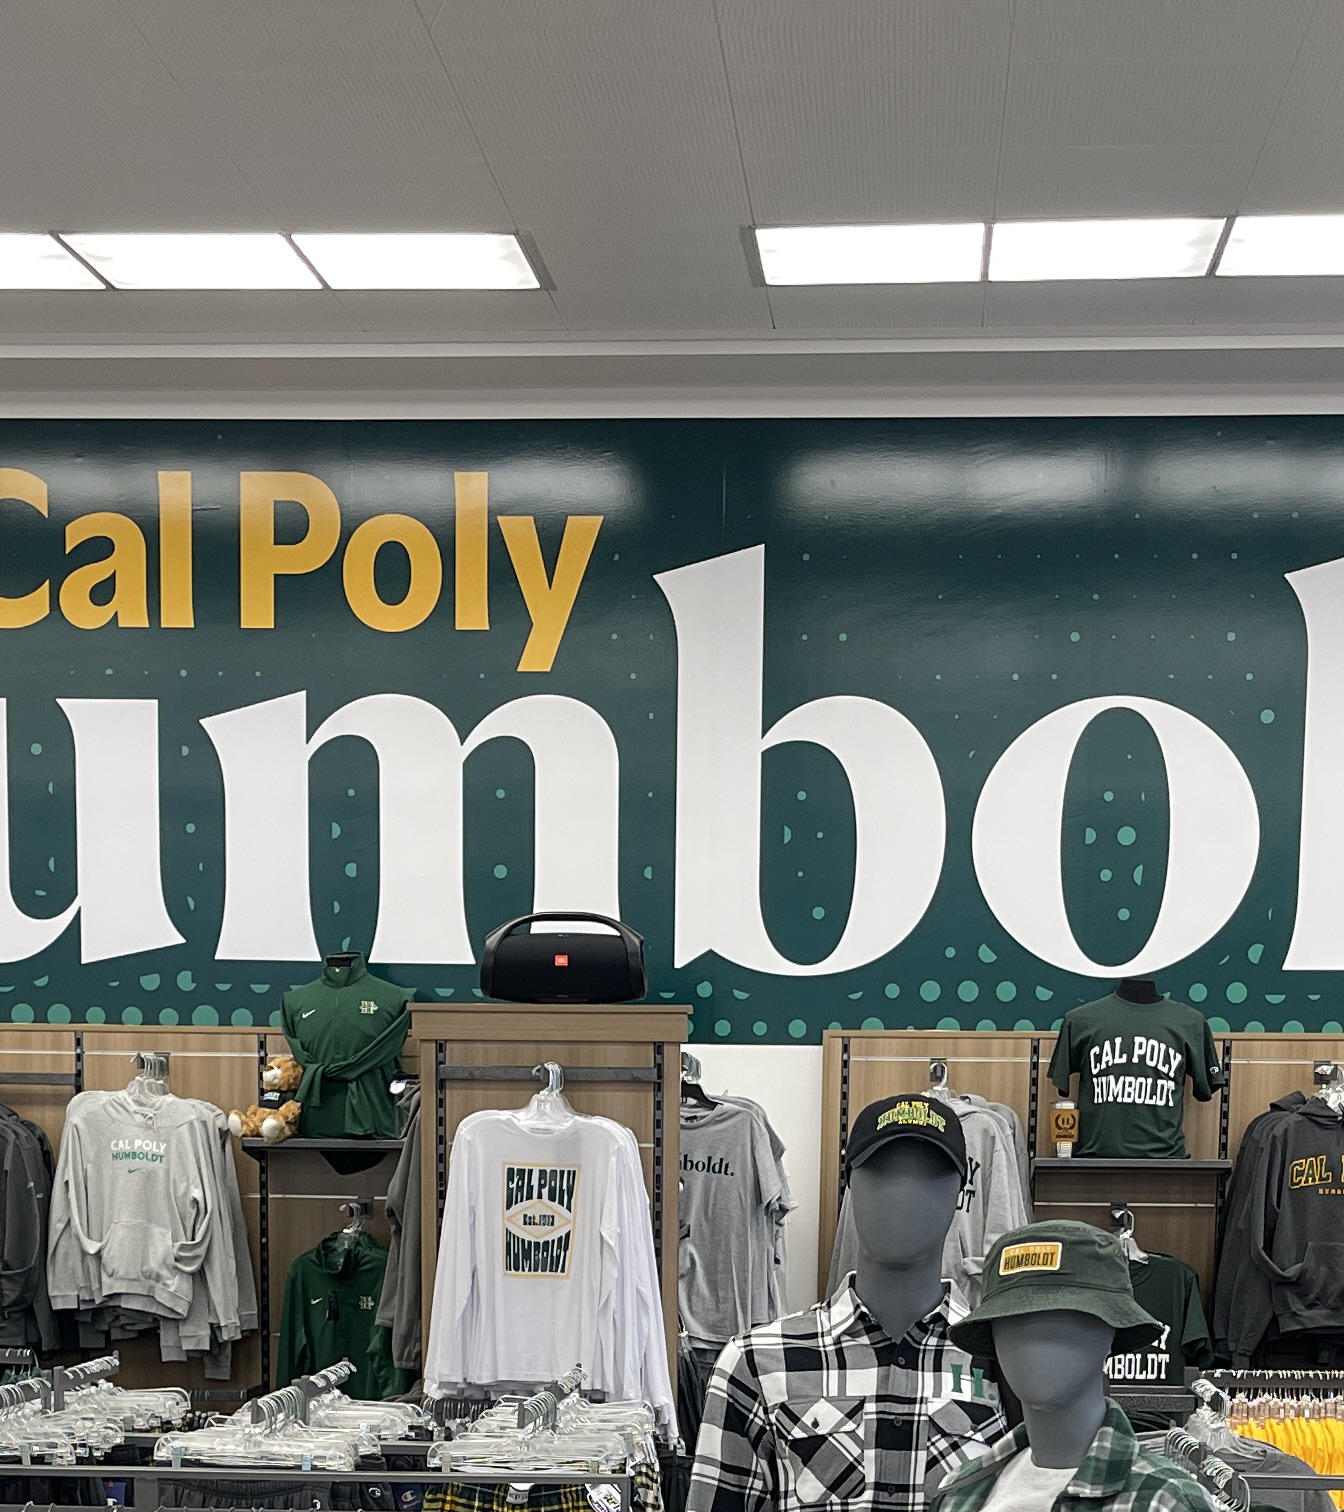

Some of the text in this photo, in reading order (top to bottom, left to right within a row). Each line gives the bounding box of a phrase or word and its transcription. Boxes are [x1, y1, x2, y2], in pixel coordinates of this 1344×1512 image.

[239, 470, 604, 672] Poly
[1089, 1036, 1182, 1079] CAL POLY
[1092, 1075, 1176, 1107] HUMBOLDT
[110, 1139, 167, 1153] CAL POLY
[111, 1151, 165, 1163] HUMBOLDT
[679, 1153, 735, 1177] boldt.
[1288, 1155, 1333, 1189] CAL
[505, 1166, 577, 1214] CAL POLY
[505, 1226, 572, 1274] HUMBOLDT
[1003, 1252, 1056, 1271] HUMBOLDT
